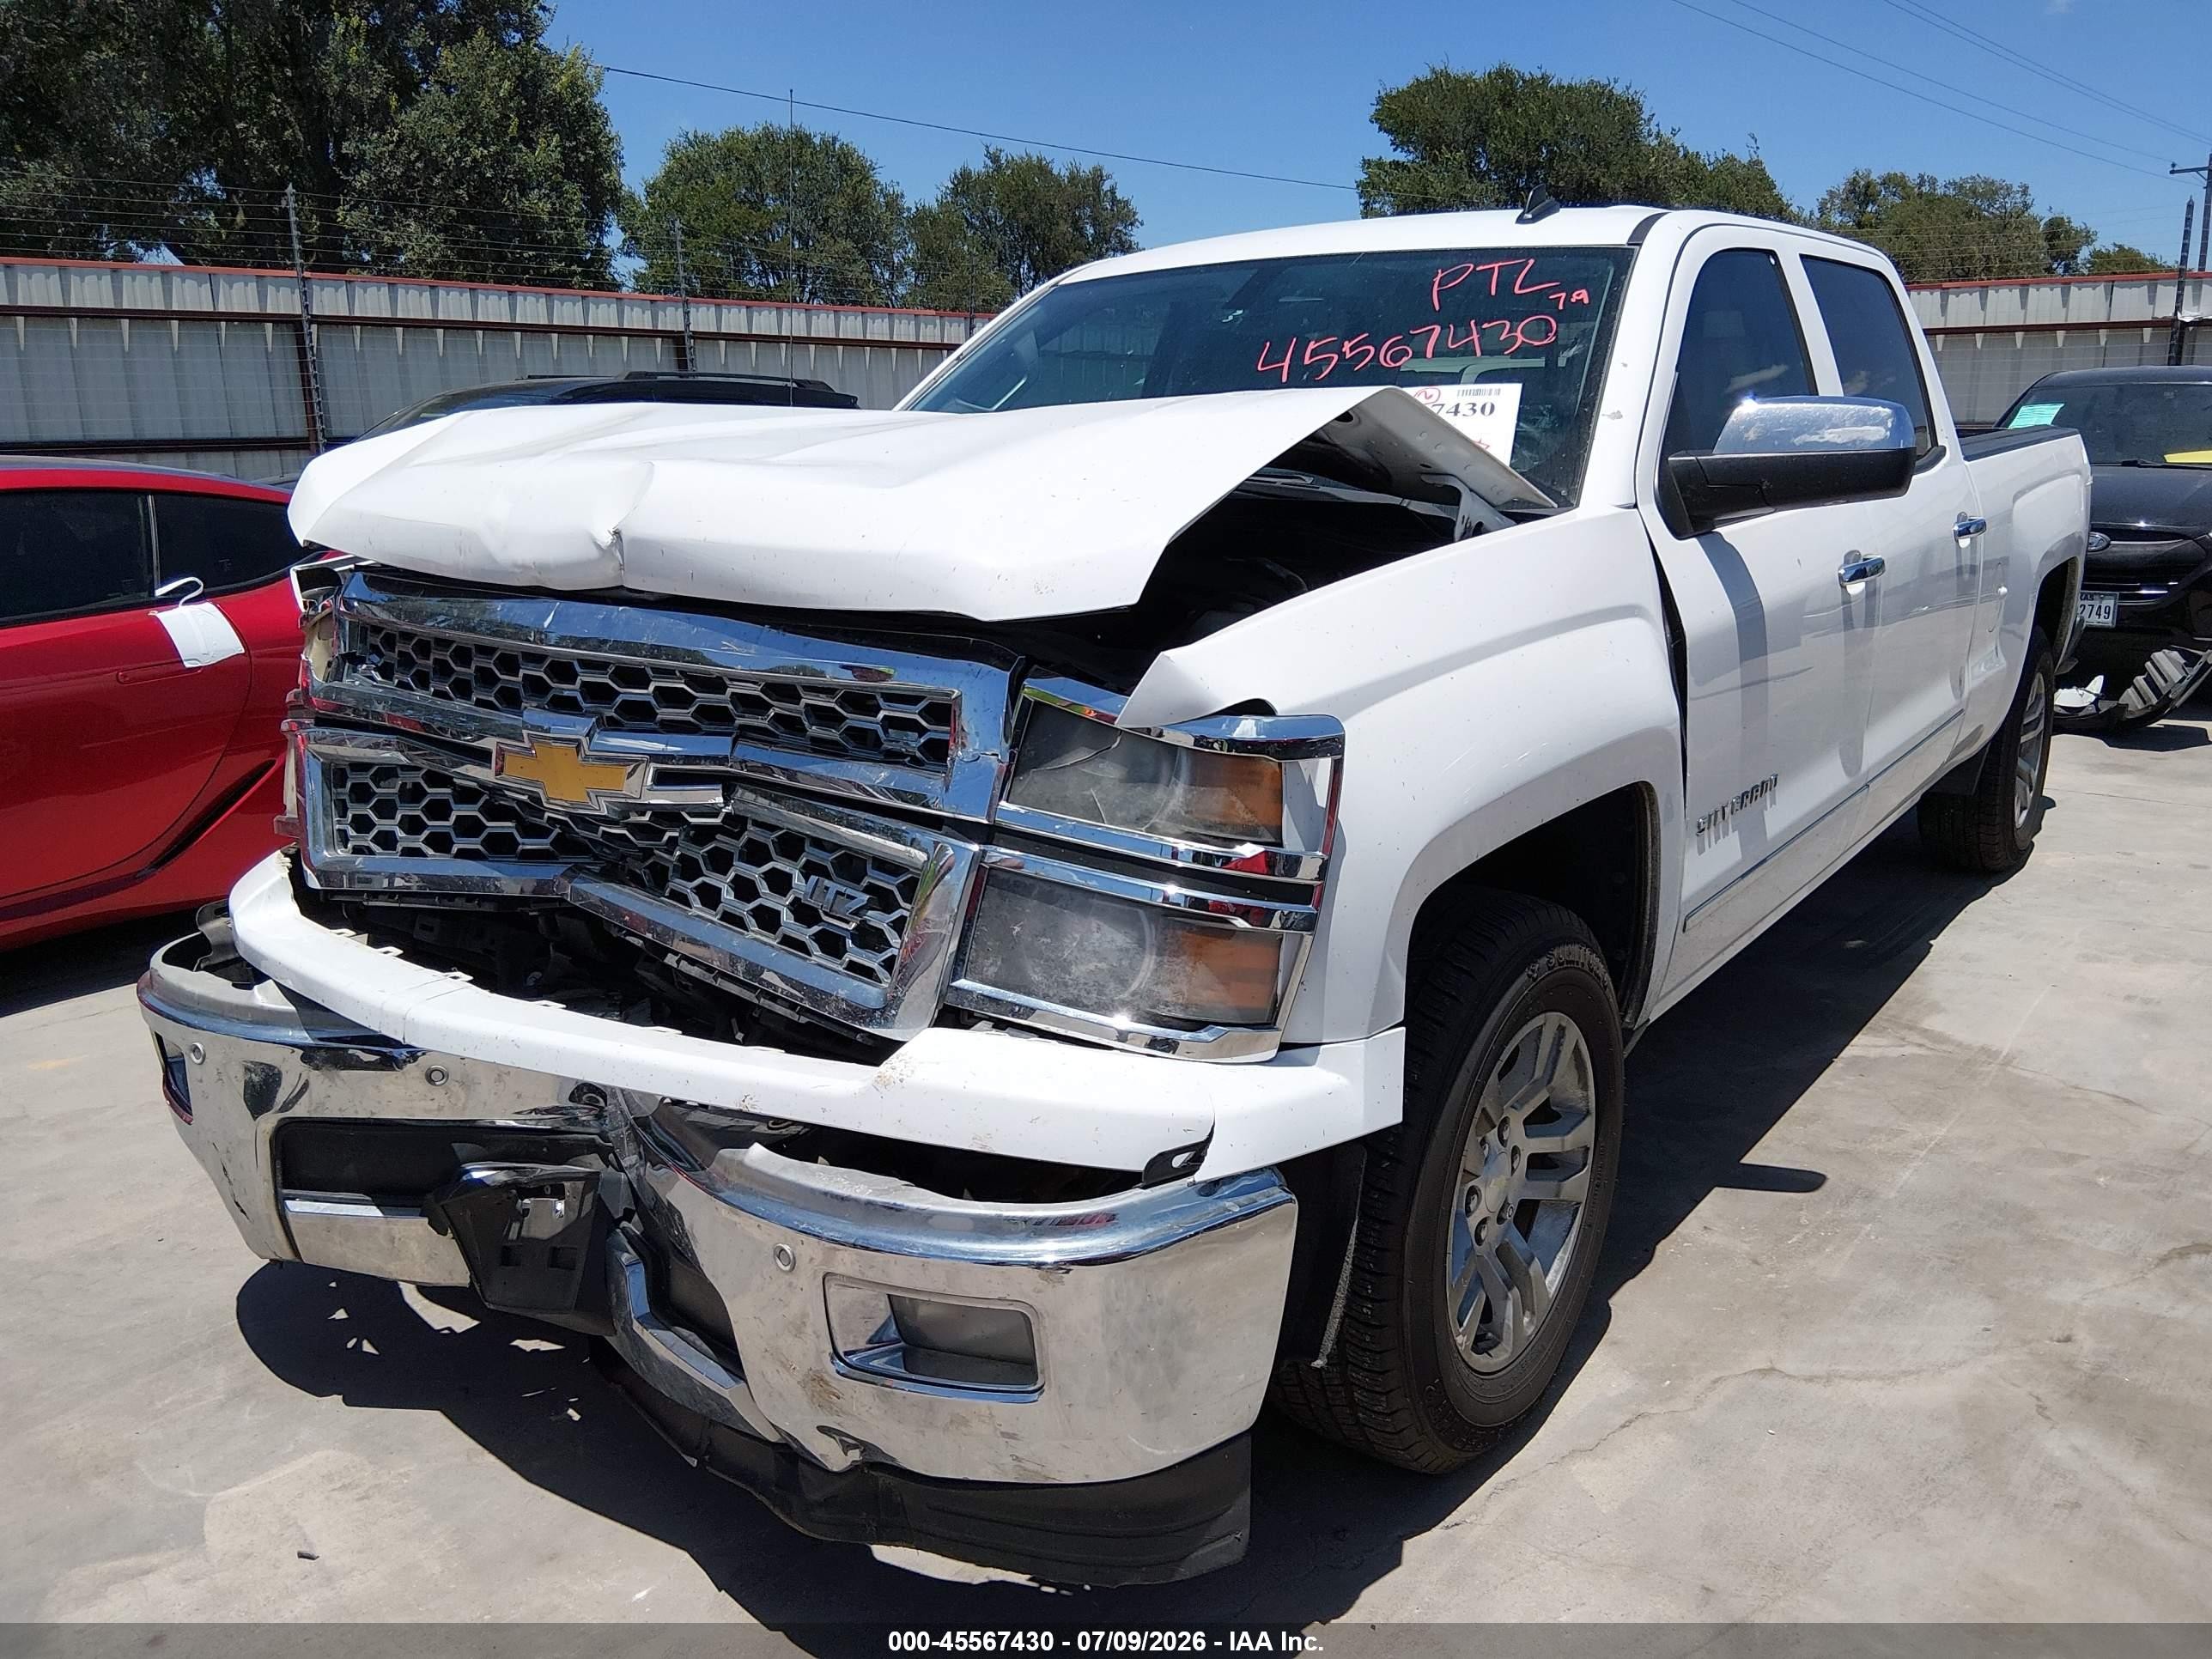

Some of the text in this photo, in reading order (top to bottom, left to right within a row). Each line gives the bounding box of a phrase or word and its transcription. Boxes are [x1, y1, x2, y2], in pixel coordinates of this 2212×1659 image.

[1431, 258, 1562, 311] PTL
[1256, 314, 1558, 383] 45567430
[802, 875, 871, 921] LTZ
